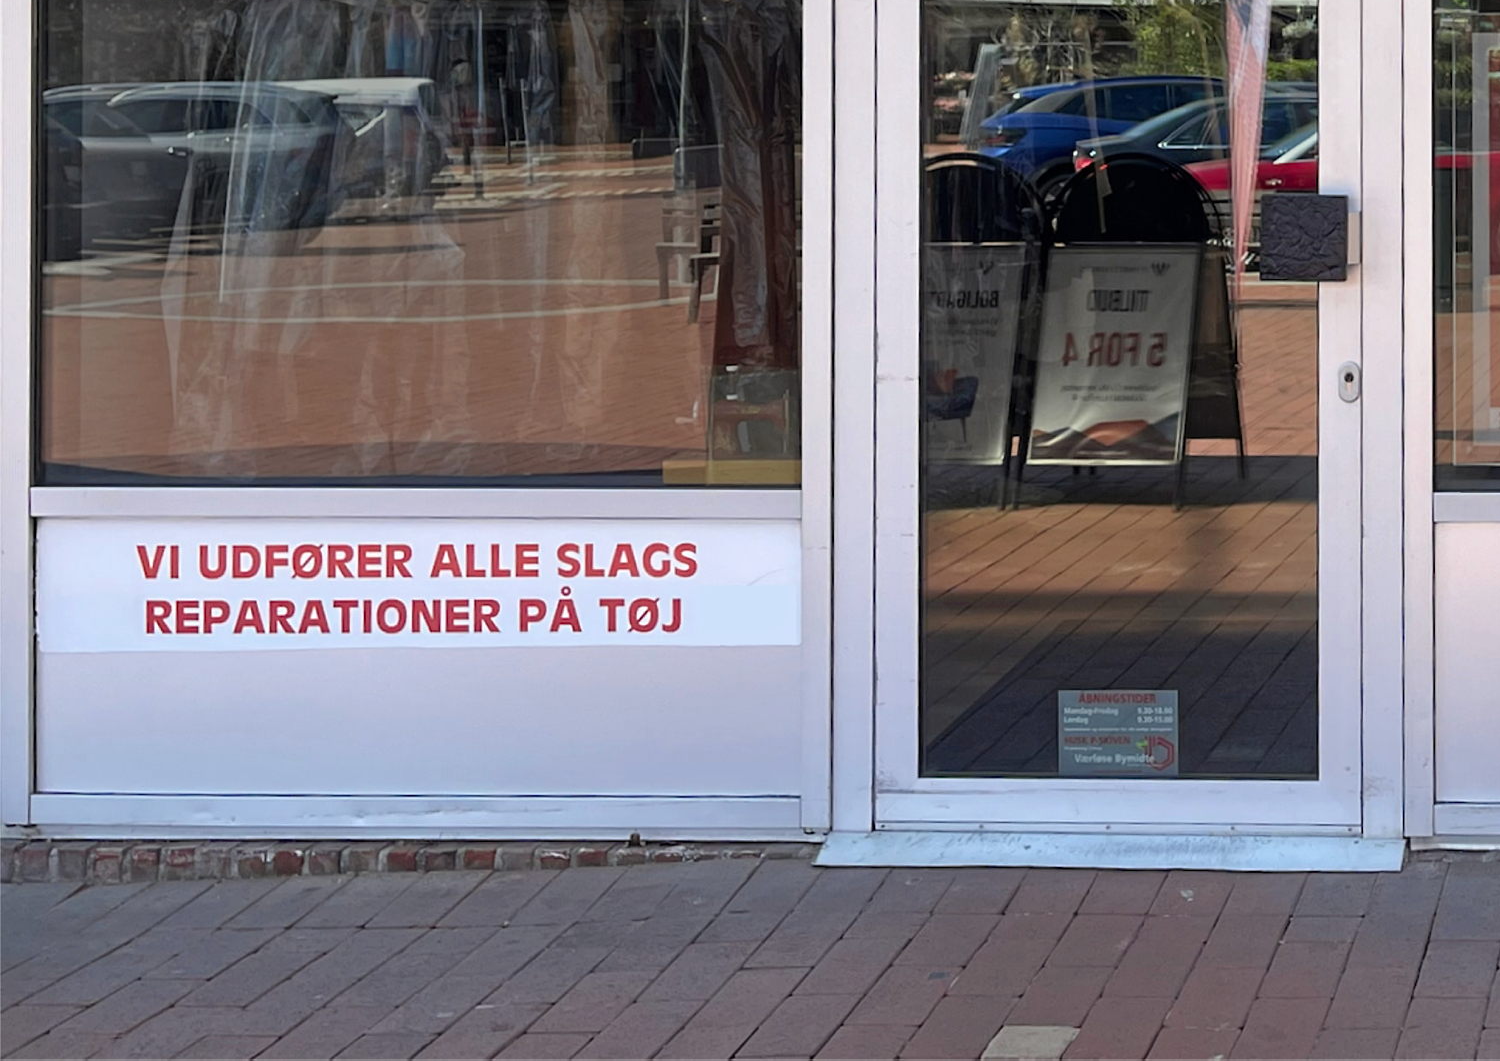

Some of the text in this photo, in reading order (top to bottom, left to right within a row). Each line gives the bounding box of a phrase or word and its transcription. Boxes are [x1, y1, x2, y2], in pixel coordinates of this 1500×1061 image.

[137, 543, 698, 580] VI UDFØRER ALLE SLAGS
[146, 587, 682, 634] REPARATIONER PÅ TØJ
